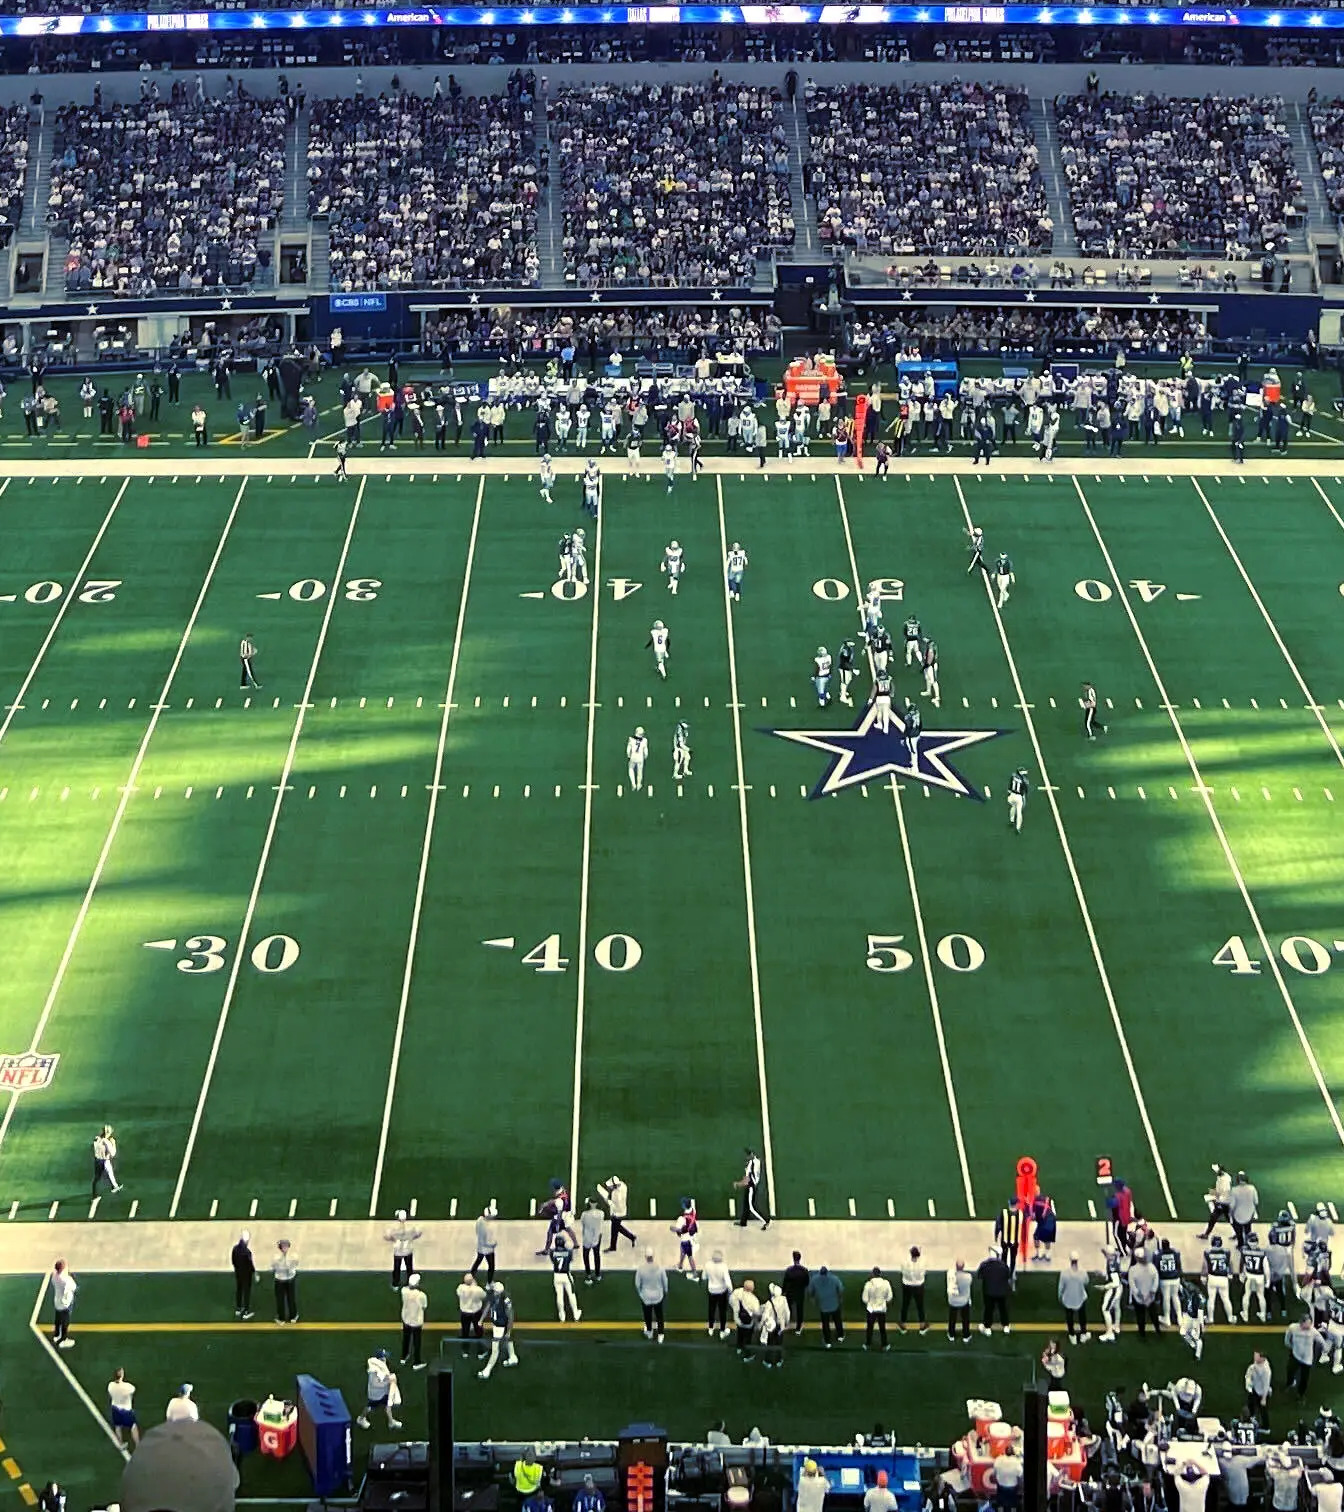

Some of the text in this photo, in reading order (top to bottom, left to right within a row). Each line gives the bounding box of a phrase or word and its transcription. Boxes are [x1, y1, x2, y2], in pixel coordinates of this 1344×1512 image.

[386, 11, 430, 23] American
[1182, 11, 1227, 23] American
[23, 579, 123, 605] 20
[288, 578, 383, 603] 30
[551, 577, 643, 602] 40
[1074, 578, 1167, 604] 40
[176, 934, 300, 974] 30
[521, 933, 643, 973] 40
[866, 933, 986, 973] 50
[1212, 935, 1332, 975] 40
[2, 1068, 42, 1086] NFL
[1098, 1158, 1112, 1176] 2
